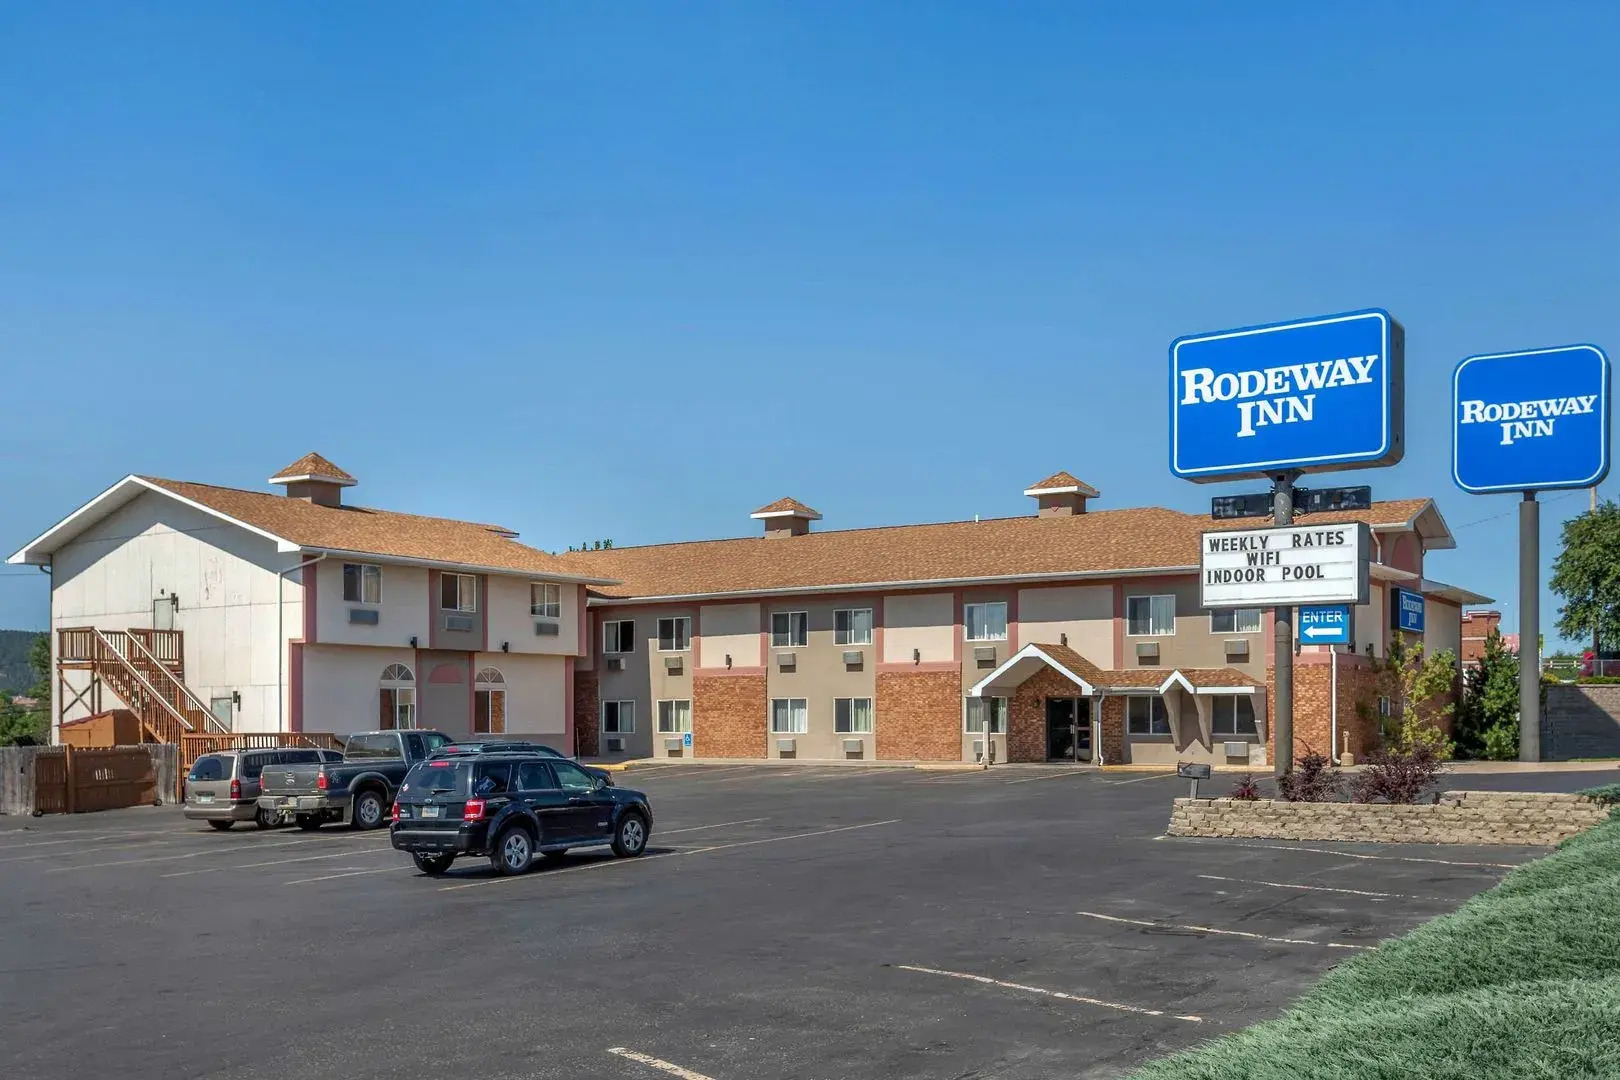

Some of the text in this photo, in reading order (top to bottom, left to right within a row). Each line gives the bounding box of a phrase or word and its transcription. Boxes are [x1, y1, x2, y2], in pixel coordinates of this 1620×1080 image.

[1181, 355, 1378, 405] RODEWAY
[1237, 394, 1316, 438] INN
[1461, 395, 1598, 423] RODEWAY
[1499, 418, 1555, 446] INN
[1209, 531, 1345, 551] WEEKLY RATES
[1247, 551, 1280, 566] WIFI
[1207, 566, 1324, 584] INDOOR POOL
[1303, 610, 1343, 623] ENTER
